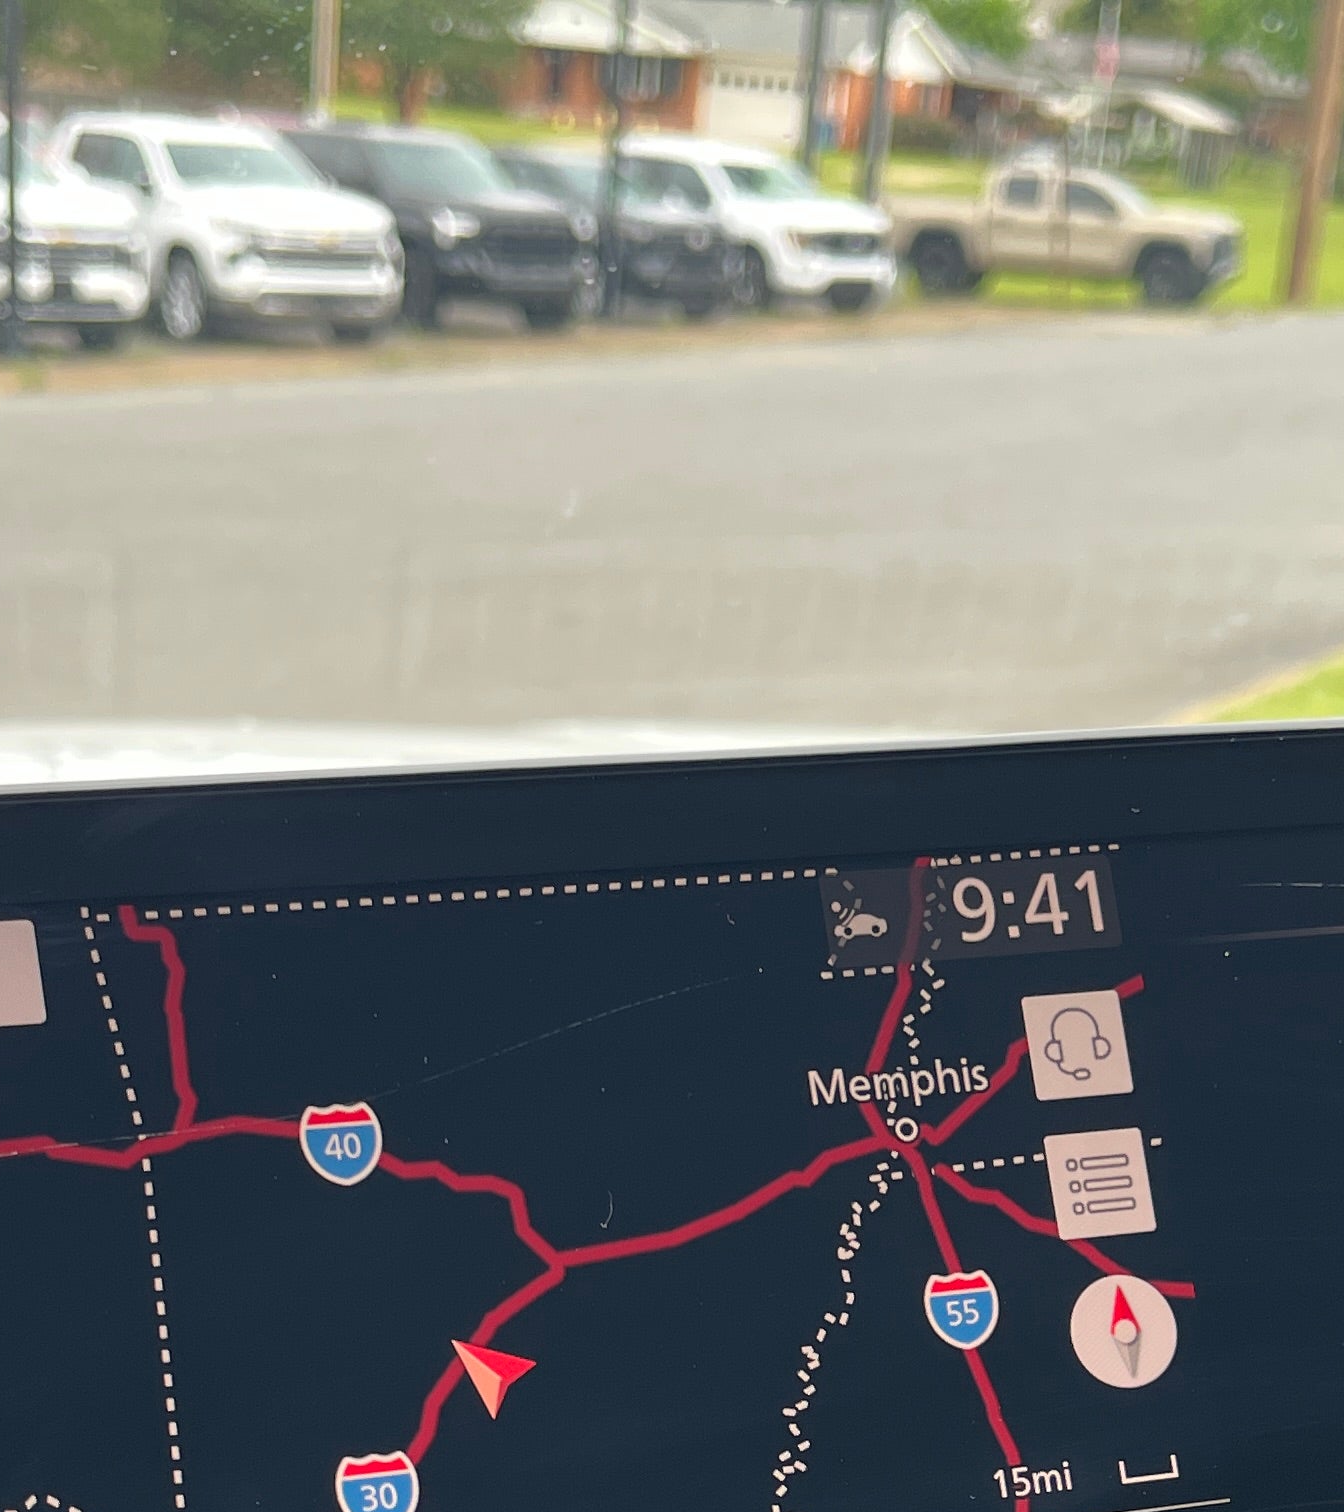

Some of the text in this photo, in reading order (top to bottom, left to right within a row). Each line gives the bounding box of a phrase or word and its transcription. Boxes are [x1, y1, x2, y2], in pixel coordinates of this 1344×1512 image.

[950, 868, 1108, 944] 9:41
[807, 1057, 991, 1107] Memphis
[324, 1131, 362, 1162] 40
[945, 1297, 981, 1327] 55
[992, 1461, 1074, 1499] 15mi
[359, 1483, 400, 1512] 30
